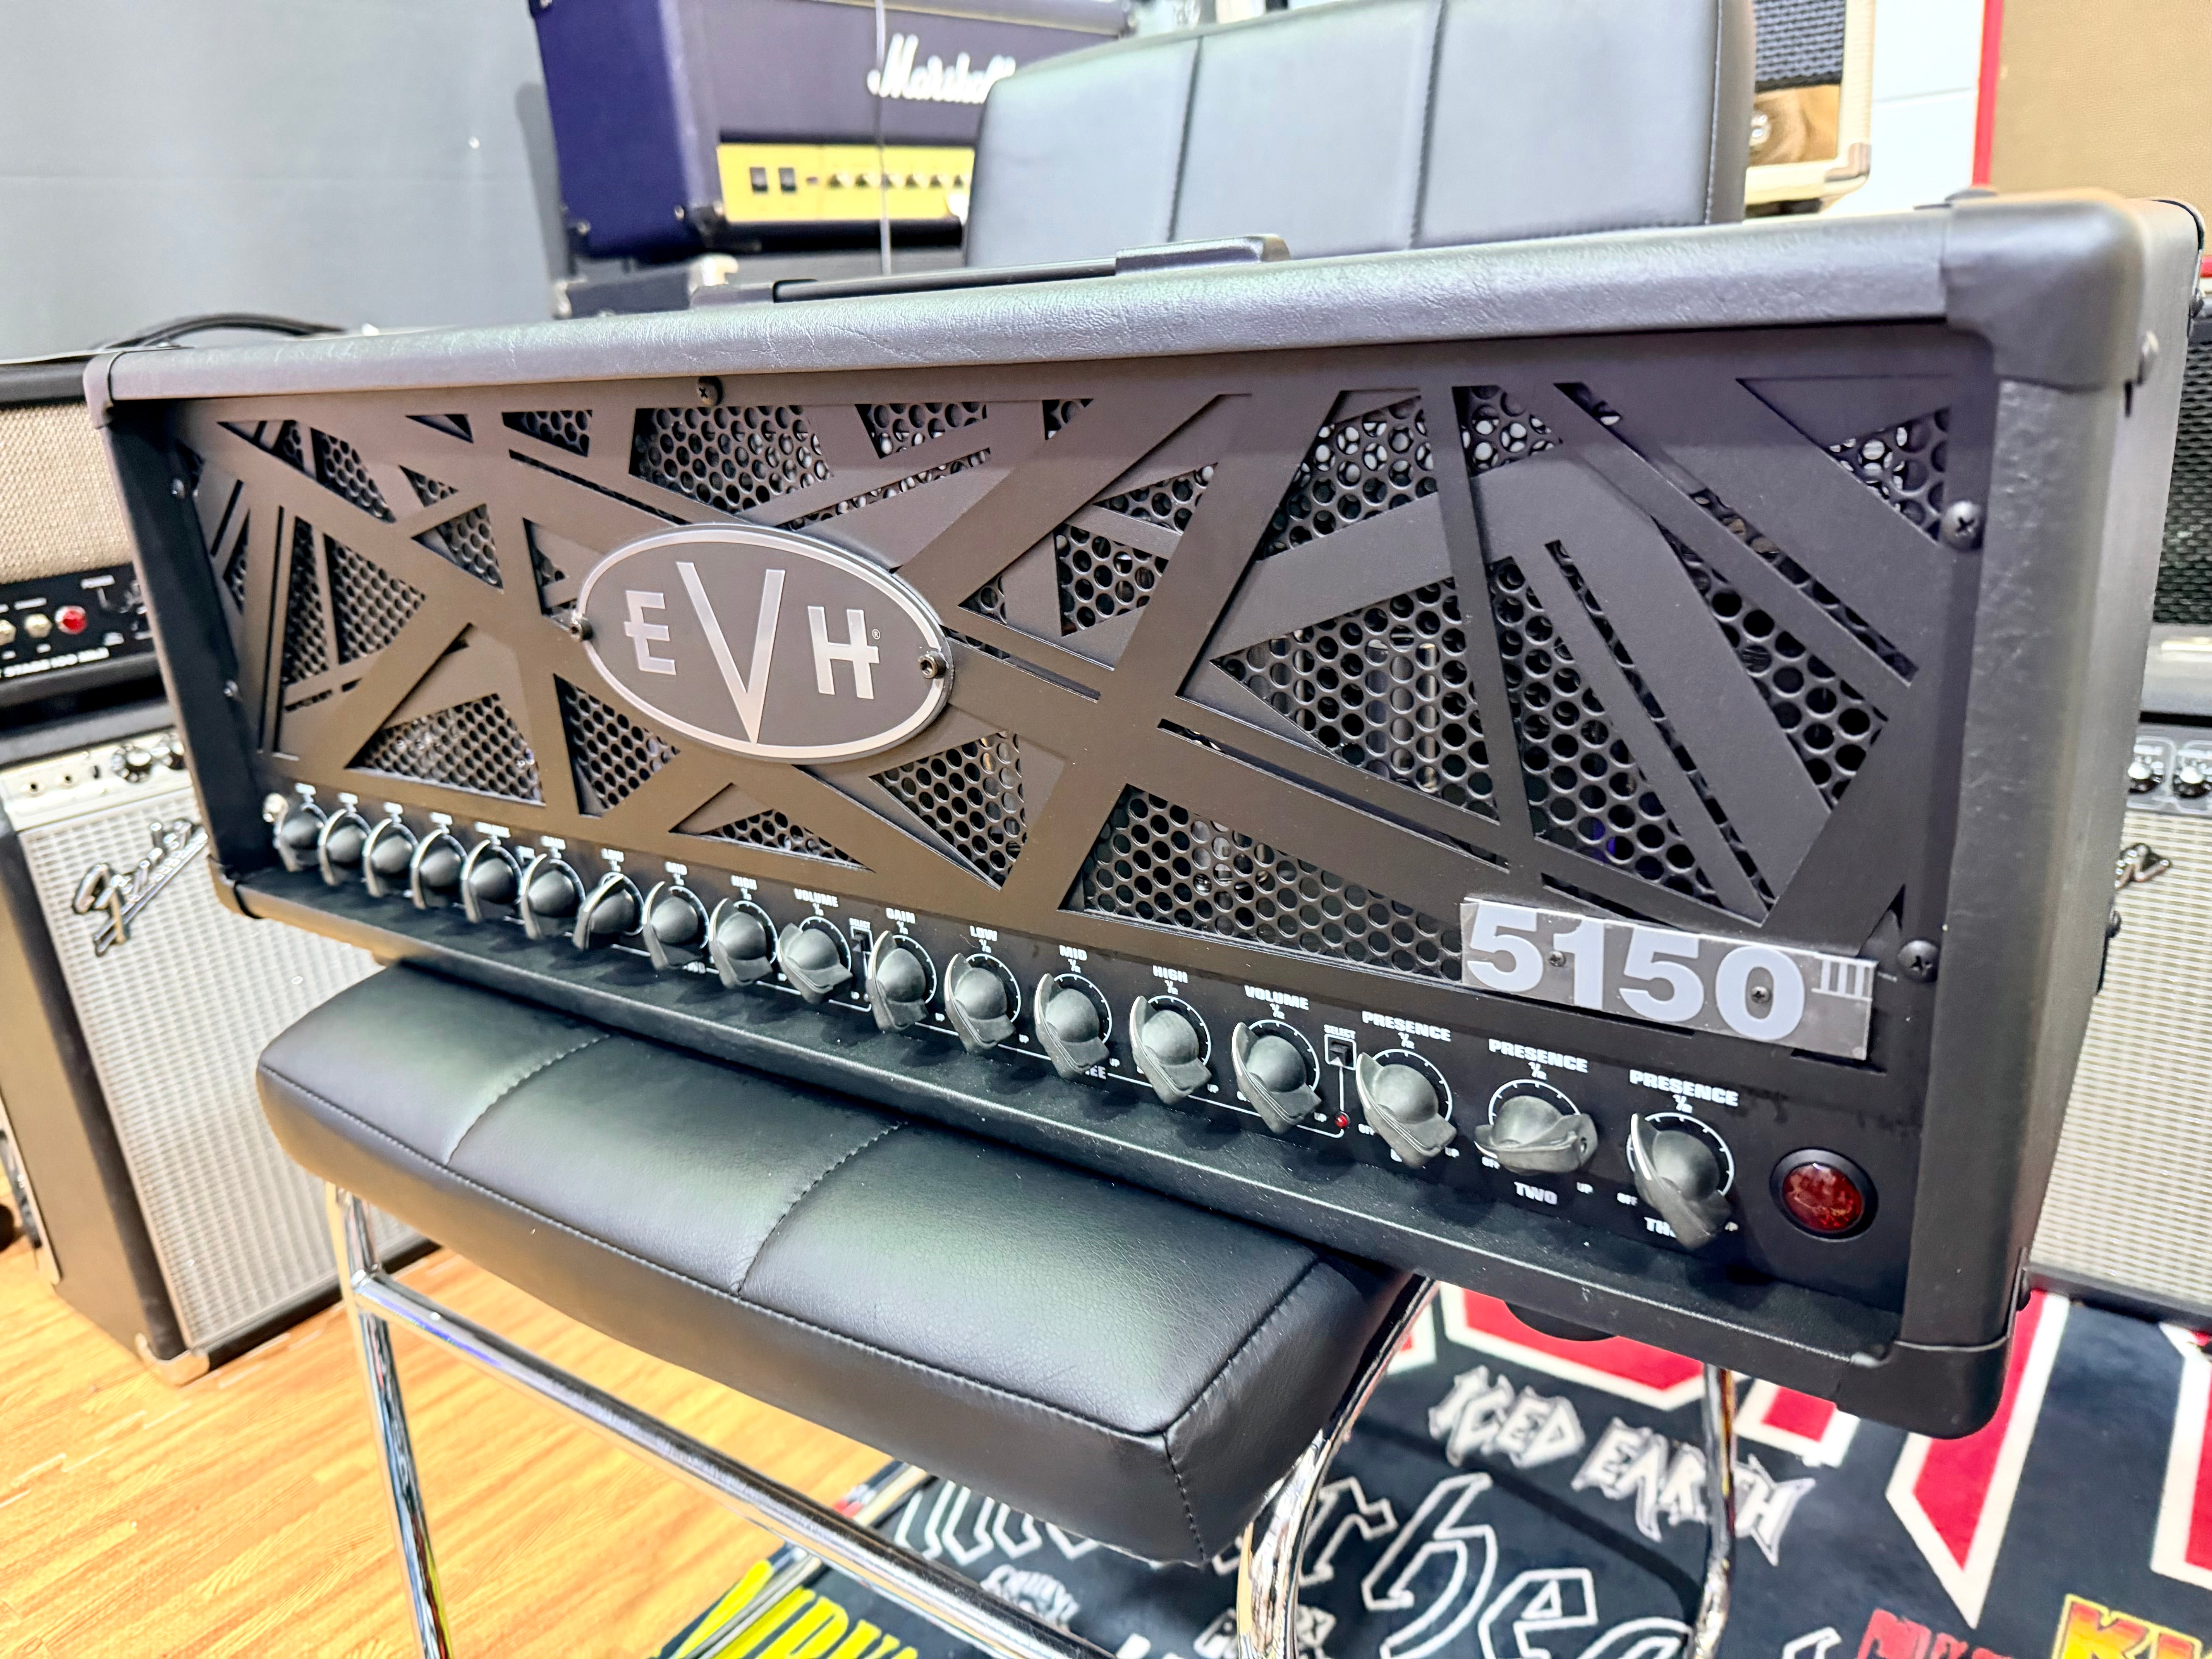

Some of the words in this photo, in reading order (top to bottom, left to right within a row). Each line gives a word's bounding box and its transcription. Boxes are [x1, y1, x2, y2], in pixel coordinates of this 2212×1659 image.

[624, 561, 879, 744] EVH
[794, 888, 838, 907] VOLUME
[886, 907, 915, 924] GAIN
[970, 926, 997, 941] LOW
[1059, 945, 1087, 961] MID
[1152, 965, 1188, 983] HIGH
[1466, 901, 1805, 1041] 5150
[1244, 985, 1309, 1010] VOLUME
[1324, 1025, 1356, 1039] SELECT
[1362, 1011, 1451, 1042] PRESENCE
[1489, 1038, 1588, 1073] PRESENCE
[1630, 1069, 1739, 1107] PRESENCE
[1514, 1182, 1558, 1205] TWO
[1428, 1366, 1585, 1468] ICED
